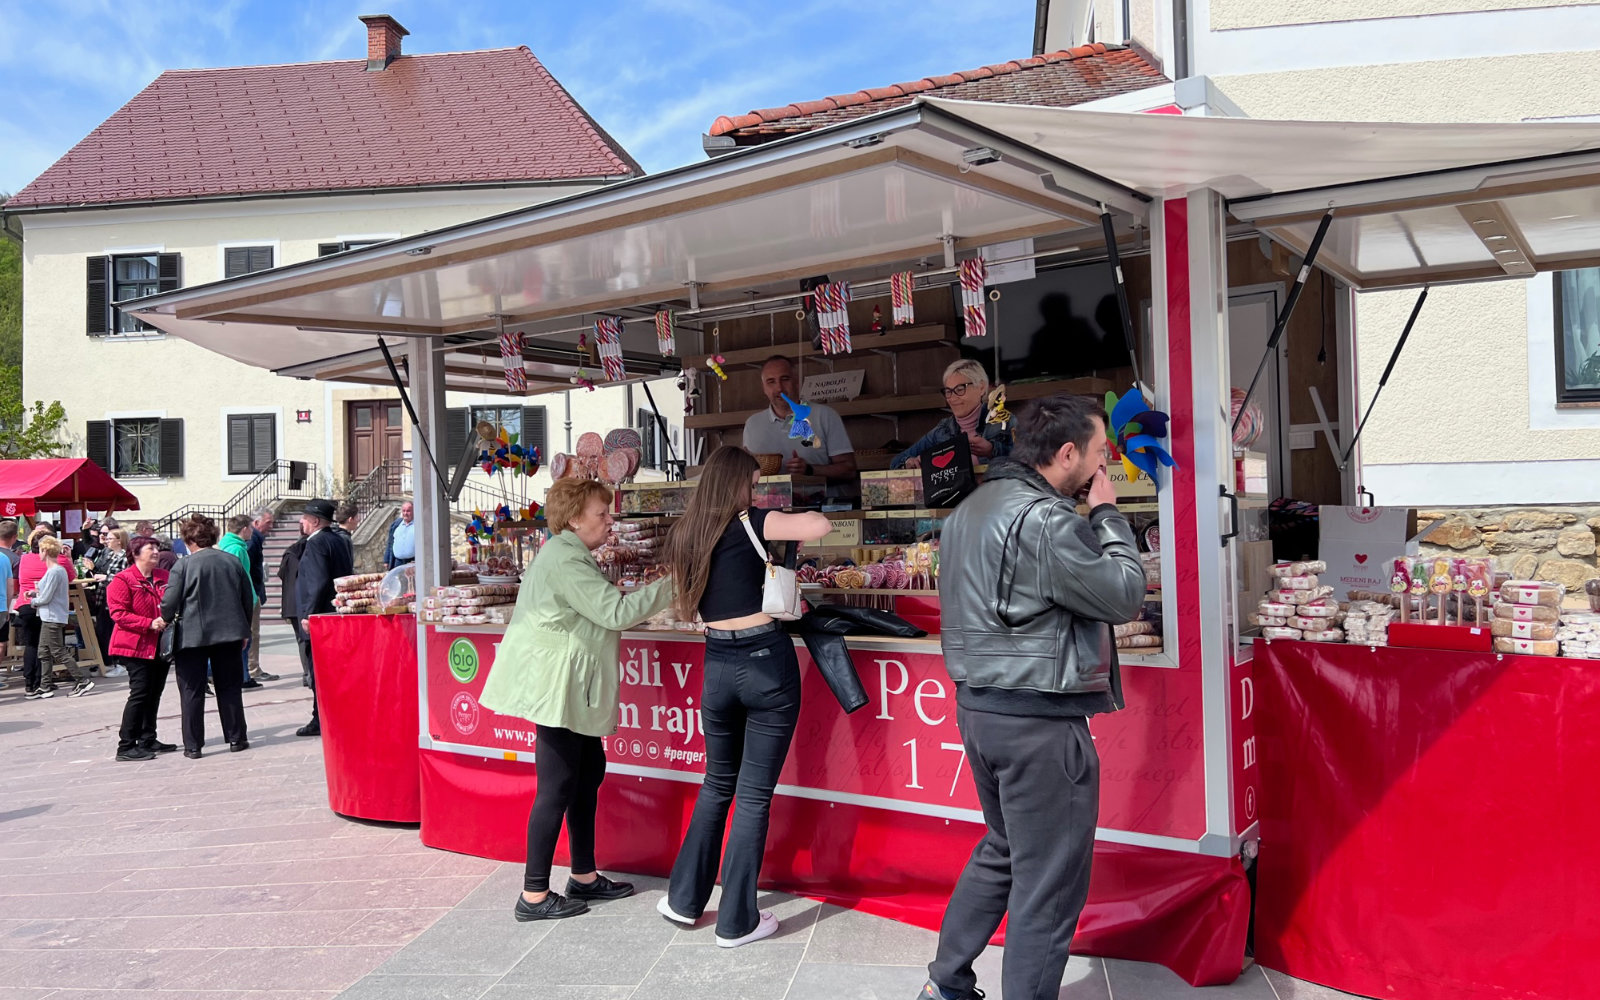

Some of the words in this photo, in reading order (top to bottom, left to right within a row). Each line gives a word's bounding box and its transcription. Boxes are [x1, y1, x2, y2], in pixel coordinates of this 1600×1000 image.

[930, 466, 959, 481] perger
[829, 520, 855, 528] ONBONI
[453, 643, 474, 667] bio
[671, 662, 693, 689] v
[873, 659, 958, 727] Pe
[494, 727, 537, 747] www.p
